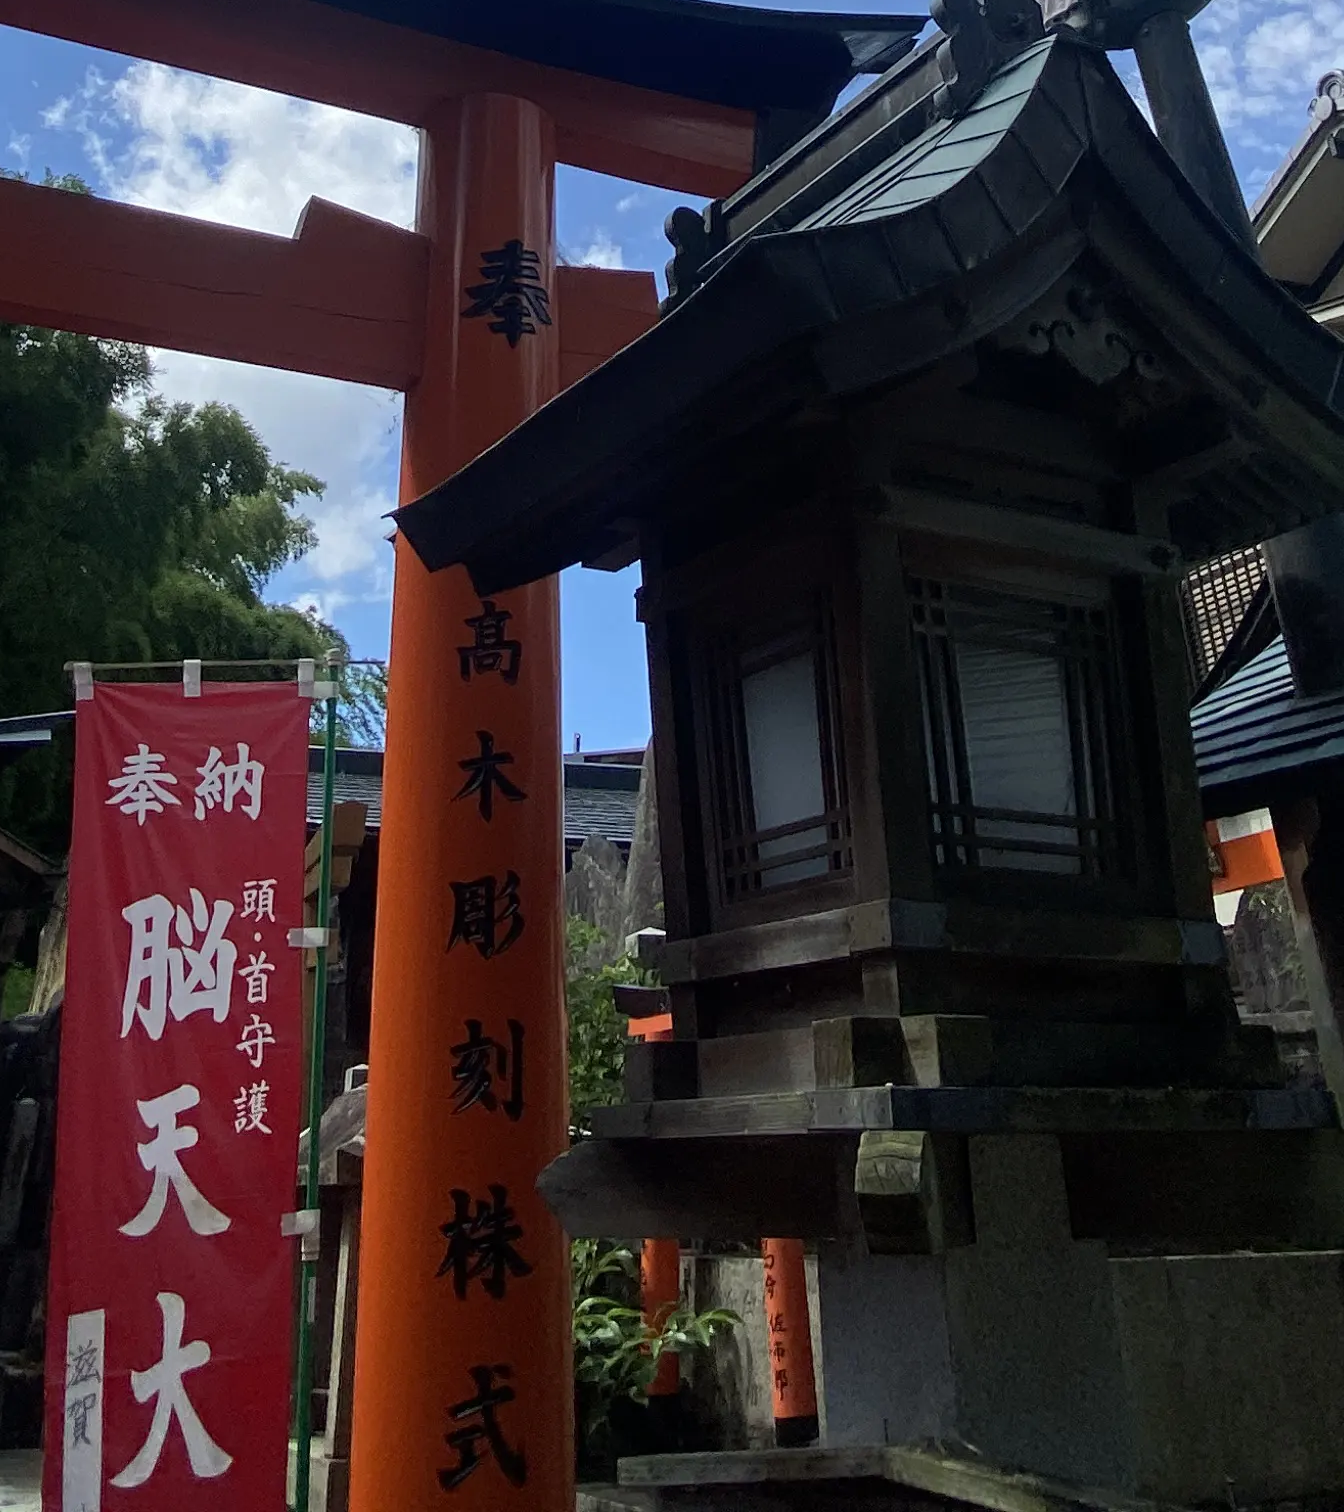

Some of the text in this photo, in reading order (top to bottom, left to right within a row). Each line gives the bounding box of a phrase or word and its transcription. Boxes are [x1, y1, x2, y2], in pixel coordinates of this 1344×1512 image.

[463, 238, 552, 348] 奉
[105, 742, 266, 826] 奉納
[111, 887, 237, 1489] 脳天大
[66, 1338, 102, 1449] 滋賀
